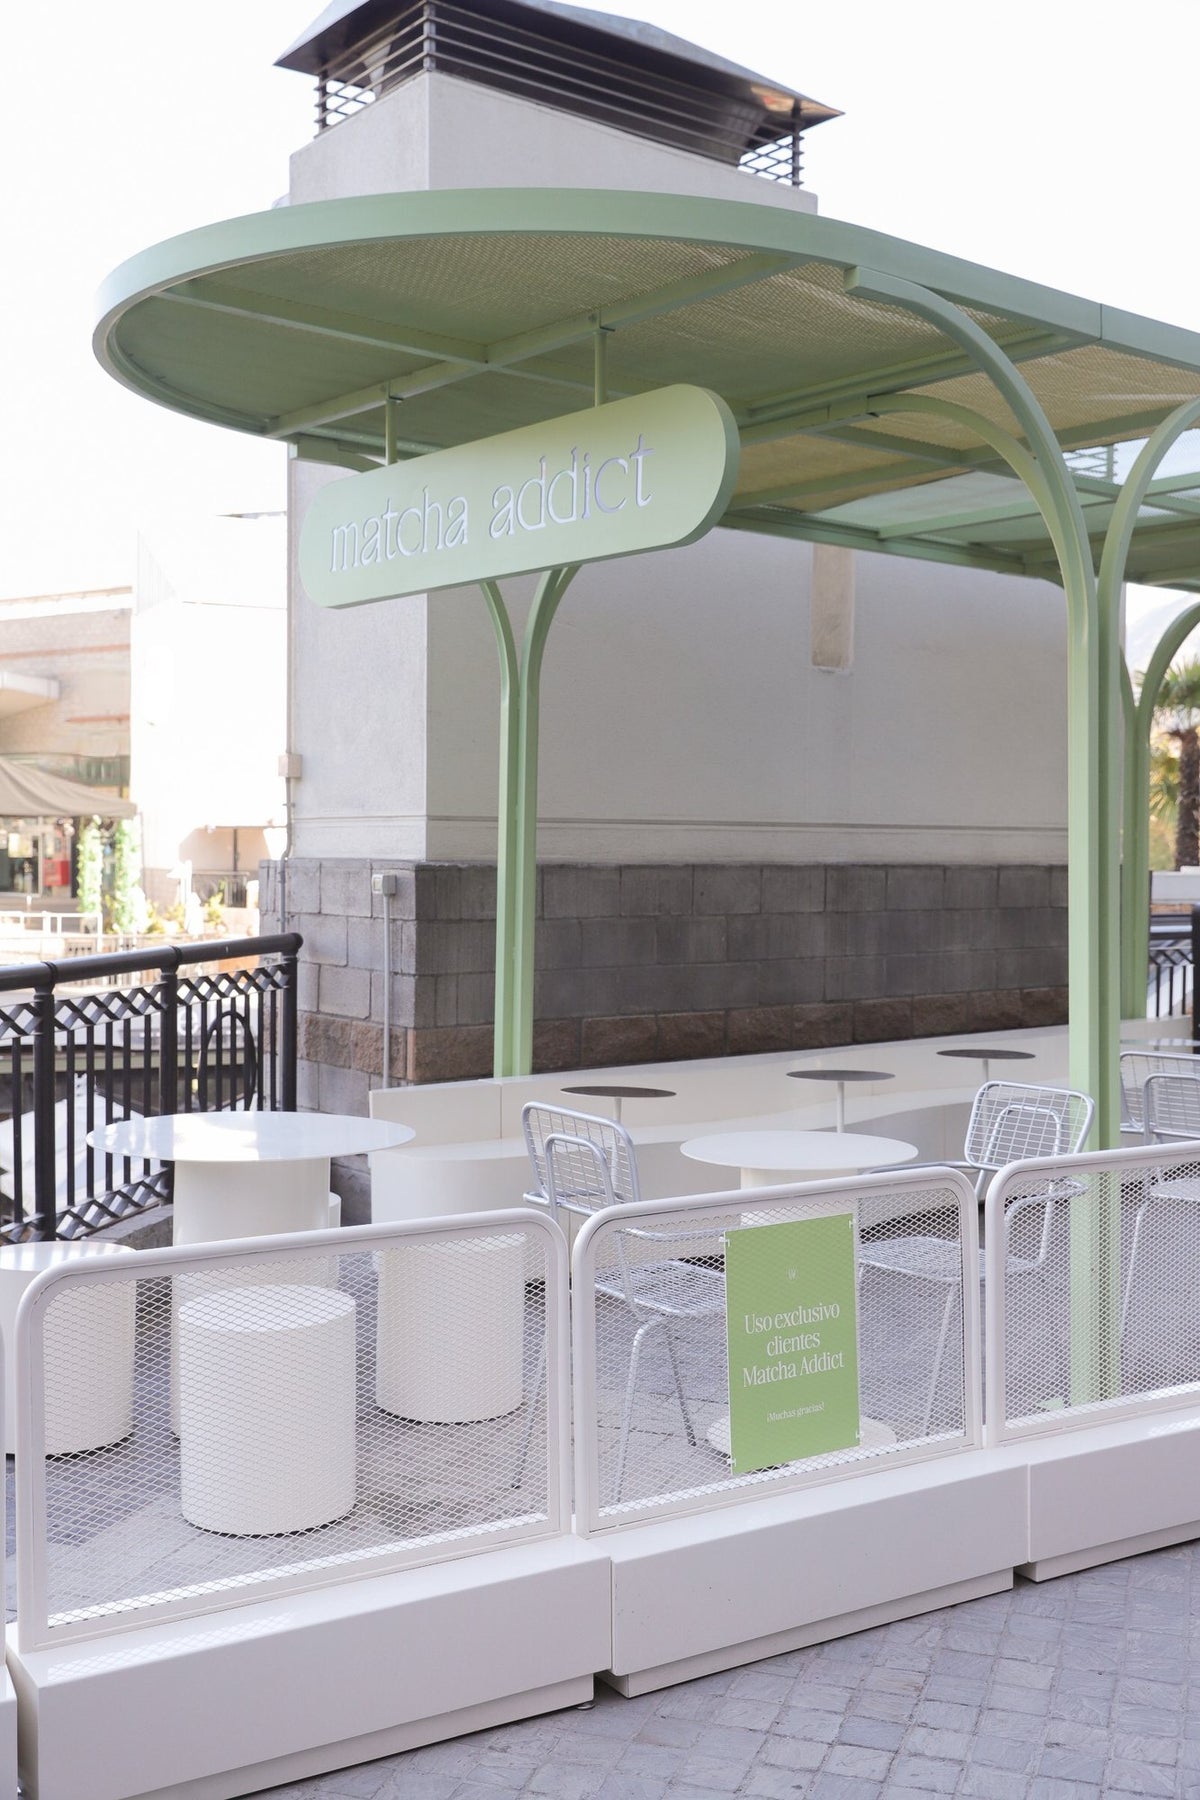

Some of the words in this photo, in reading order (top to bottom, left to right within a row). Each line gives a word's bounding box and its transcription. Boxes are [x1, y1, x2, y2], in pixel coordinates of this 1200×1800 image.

[330, 486, 469, 573] matcha
[488, 434, 656, 539] addict
[744, 1313, 772, 1334] Uso
[774, 1303, 840, 1328] exclusivo
[766, 1332, 820, 1356] clientes
[743, 1361, 797, 1387] Matcha
[800, 1351, 845, 1375] Addict
